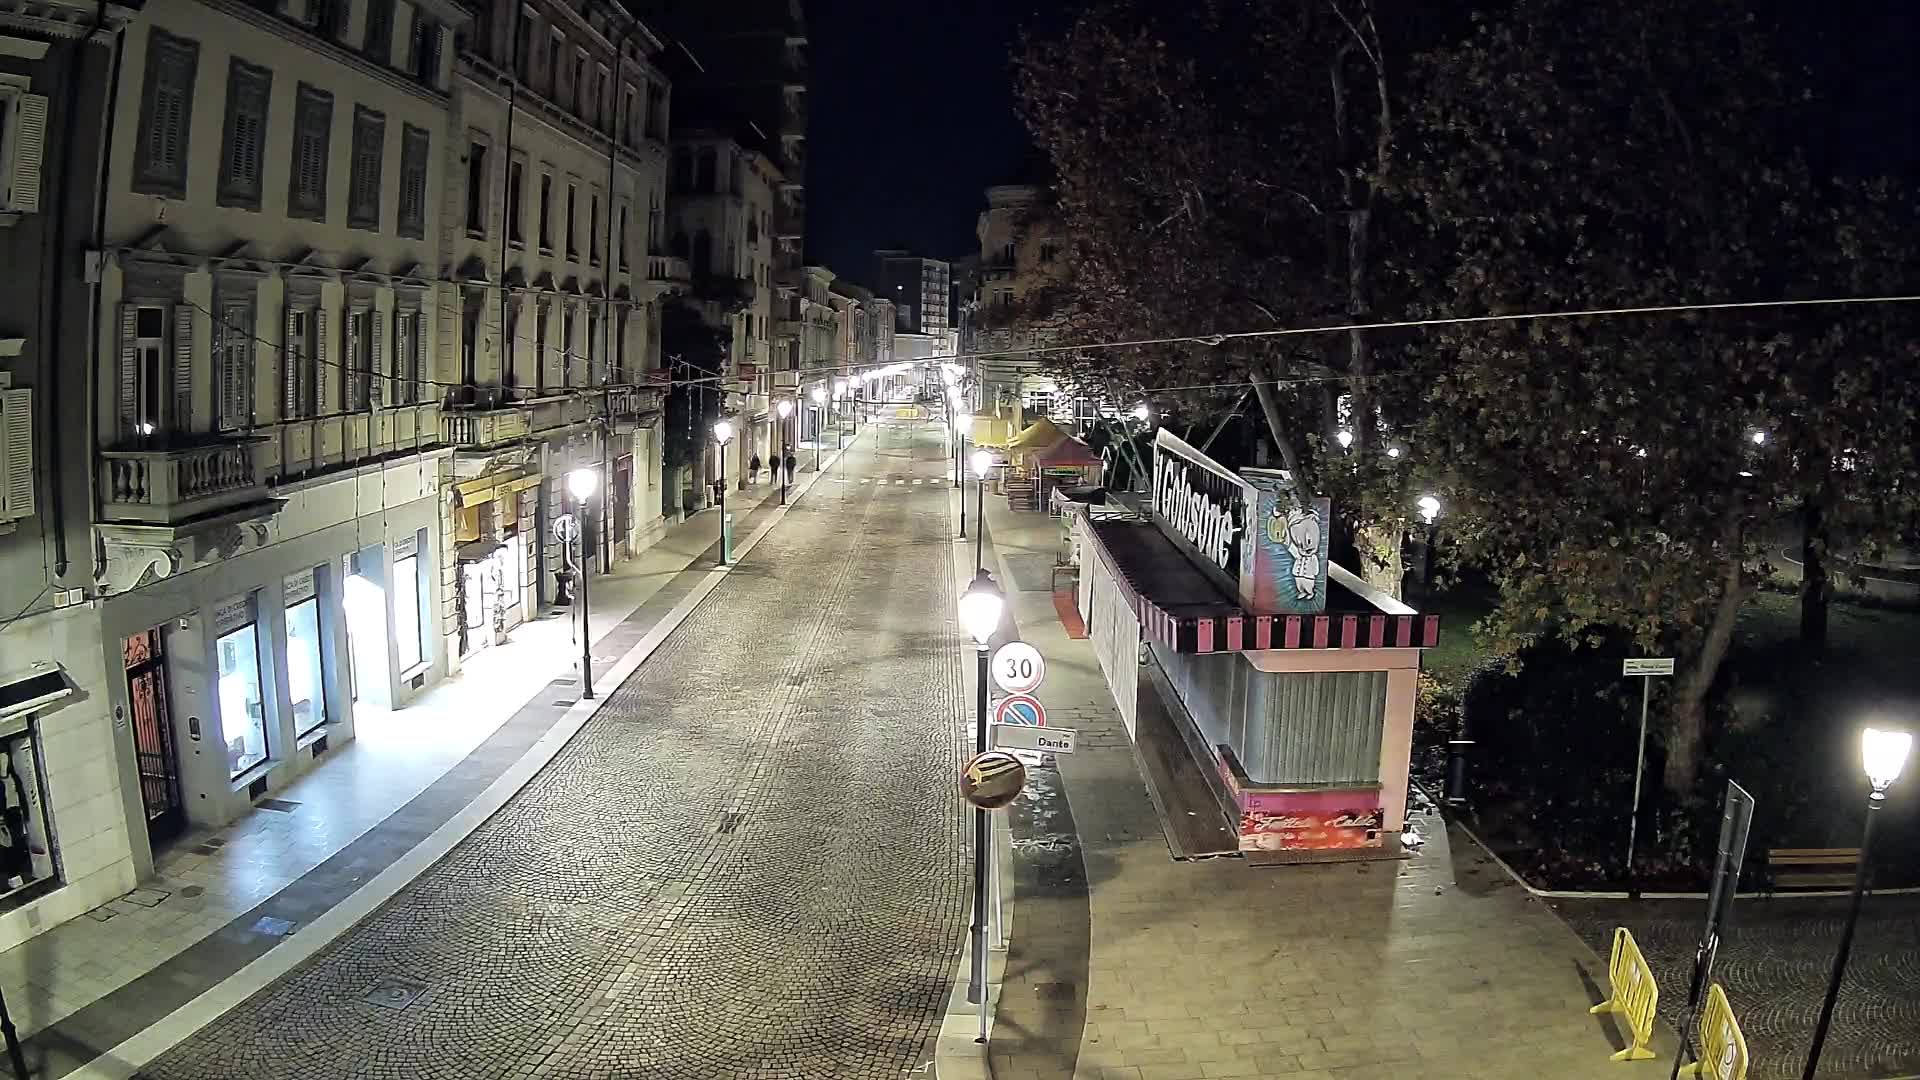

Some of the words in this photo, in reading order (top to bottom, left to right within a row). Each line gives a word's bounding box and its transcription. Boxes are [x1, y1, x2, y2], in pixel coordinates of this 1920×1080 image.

[1162, 458, 1233, 569] Golosone
[1006, 658, 1032, 679] 30
[1038, 737, 1069, 749] Dante
